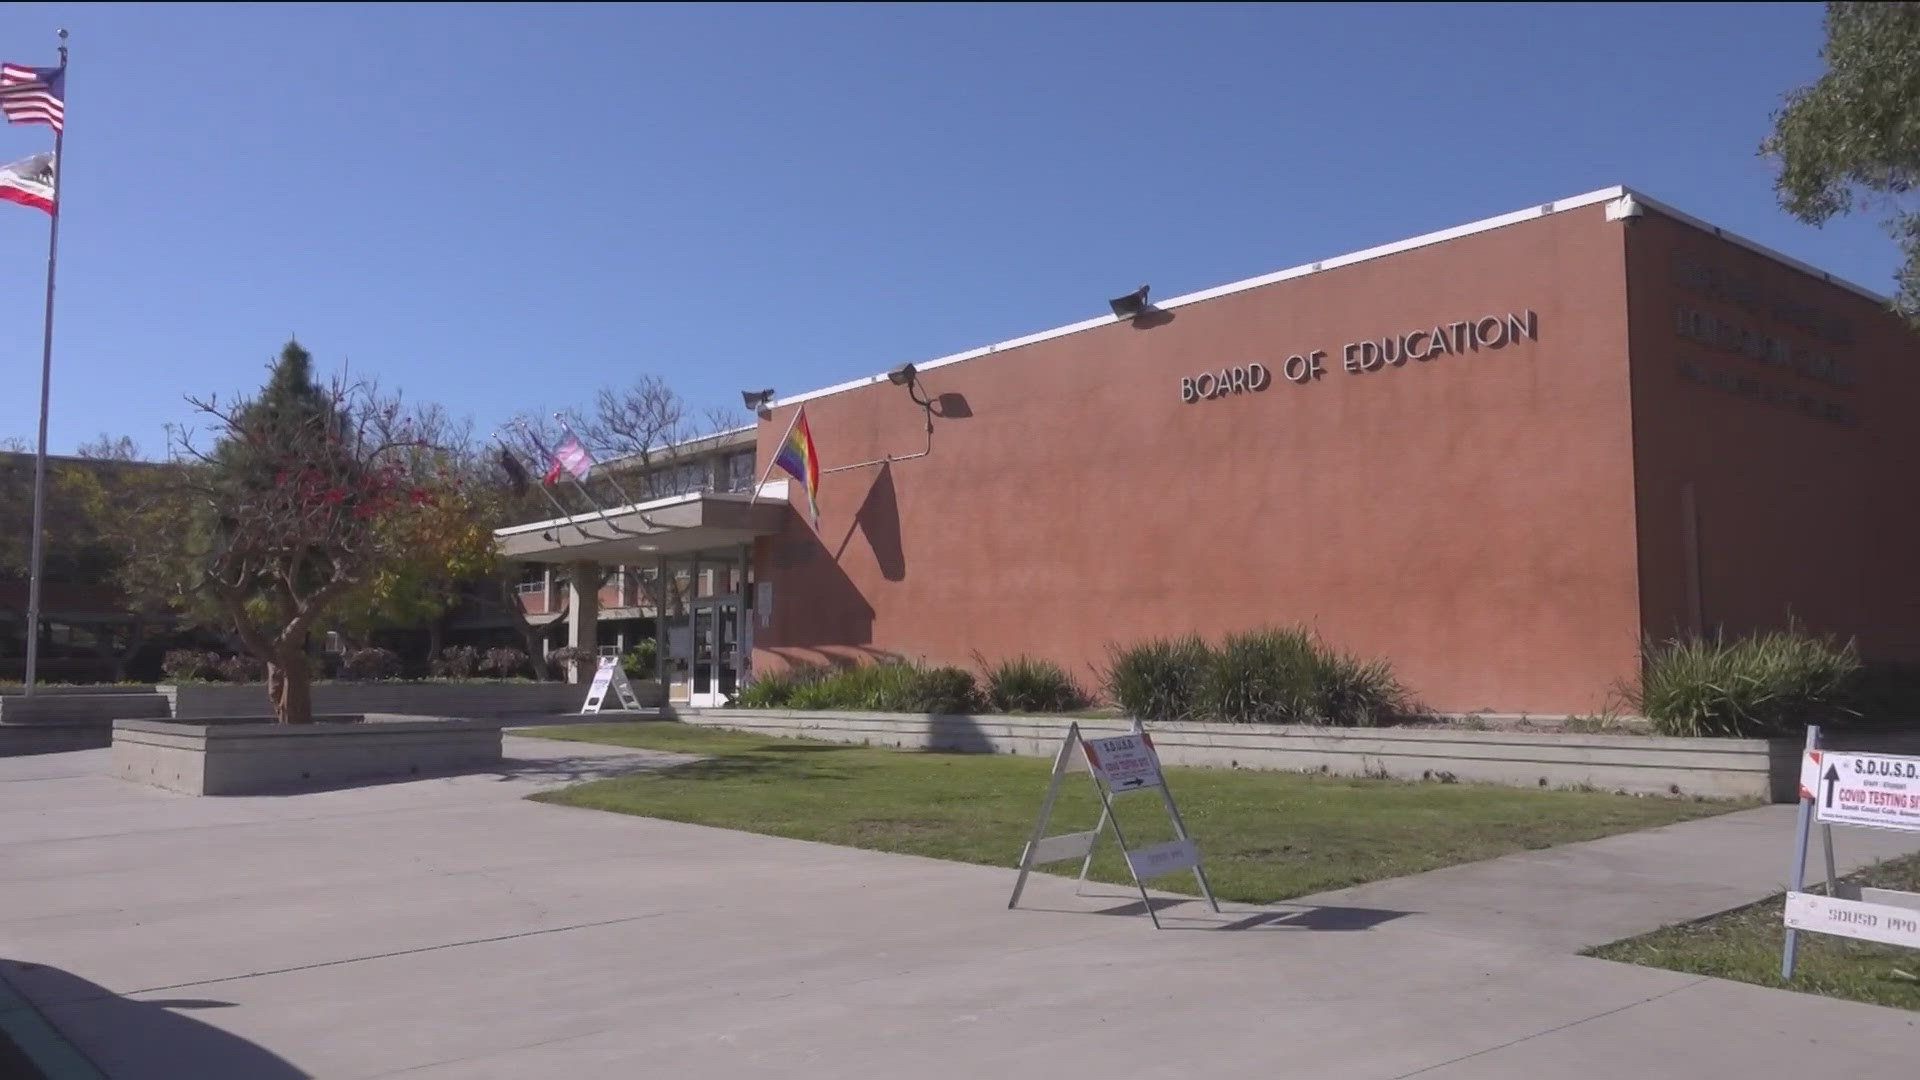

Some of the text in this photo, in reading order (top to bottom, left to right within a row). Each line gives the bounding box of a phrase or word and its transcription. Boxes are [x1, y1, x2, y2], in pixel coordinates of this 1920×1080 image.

[1180, 309, 1534, 402] BOARD OF EDUCATION
[1855, 758, 1919, 779] S.D.U.S.D.
[1839, 788, 1866, 803] COVID
[1869, 791, 1907, 808] TESTING
[1829, 909, 1878, 927] SDUSD
